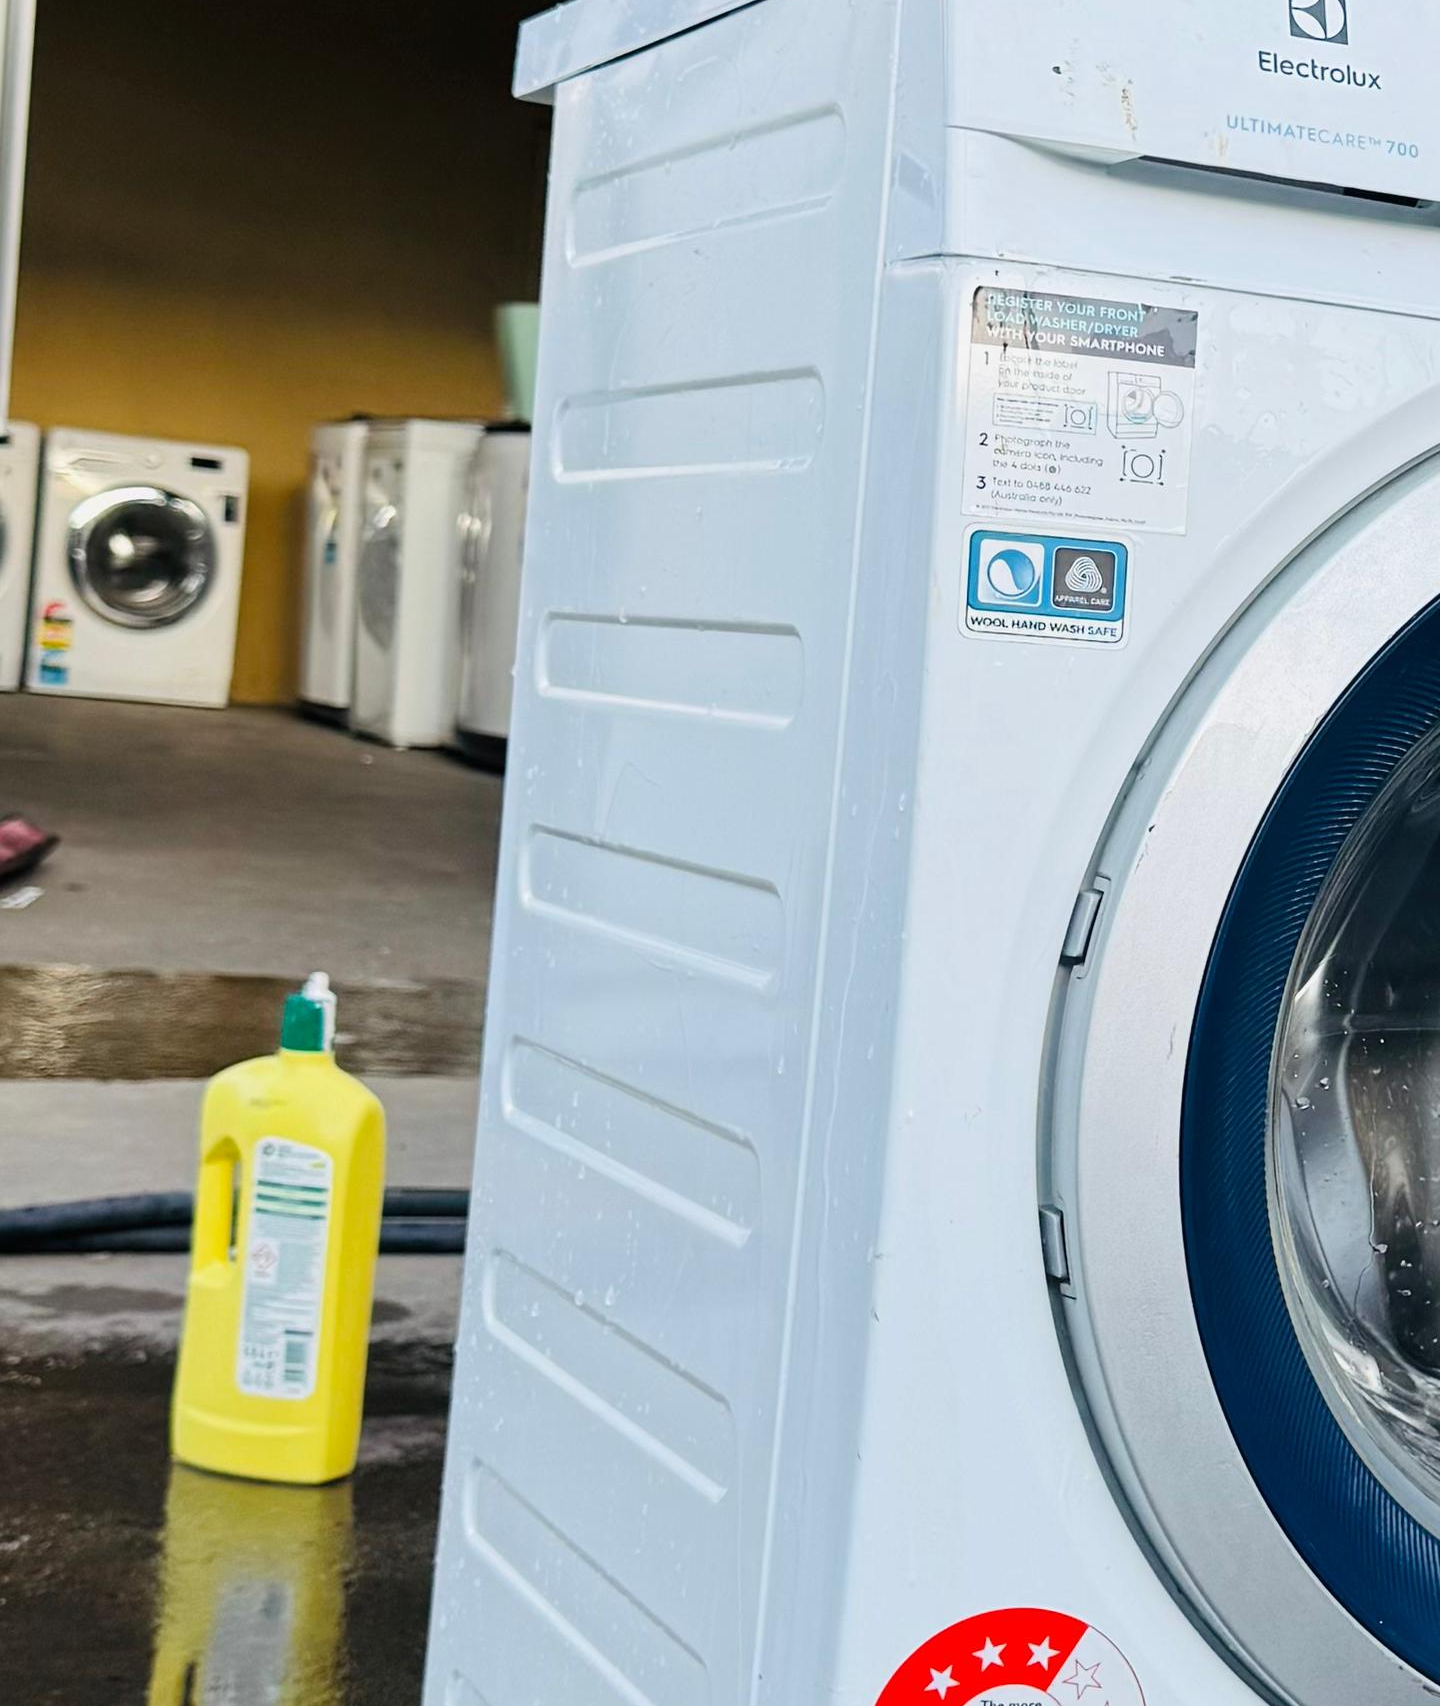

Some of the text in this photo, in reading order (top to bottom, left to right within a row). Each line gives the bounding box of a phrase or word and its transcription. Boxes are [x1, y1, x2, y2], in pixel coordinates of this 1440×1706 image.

[1258, 50, 1382, 90] Electrolux
[1386, 140, 1419, 158] 700
[987, 292, 1146, 323] REGISTER YOUR FRONT
[986, 311, 1138, 338] LOAD WASHER/DRYER
[986, 325, 1165, 357] WITH YOUR SMARTPHONE
[984, 351, 989, 365] 1
[979, 432, 989, 447] 2
[976, 475, 986, 490] 3
[970, 615, 1118, 637] WOOL HAND WASH SAFE
